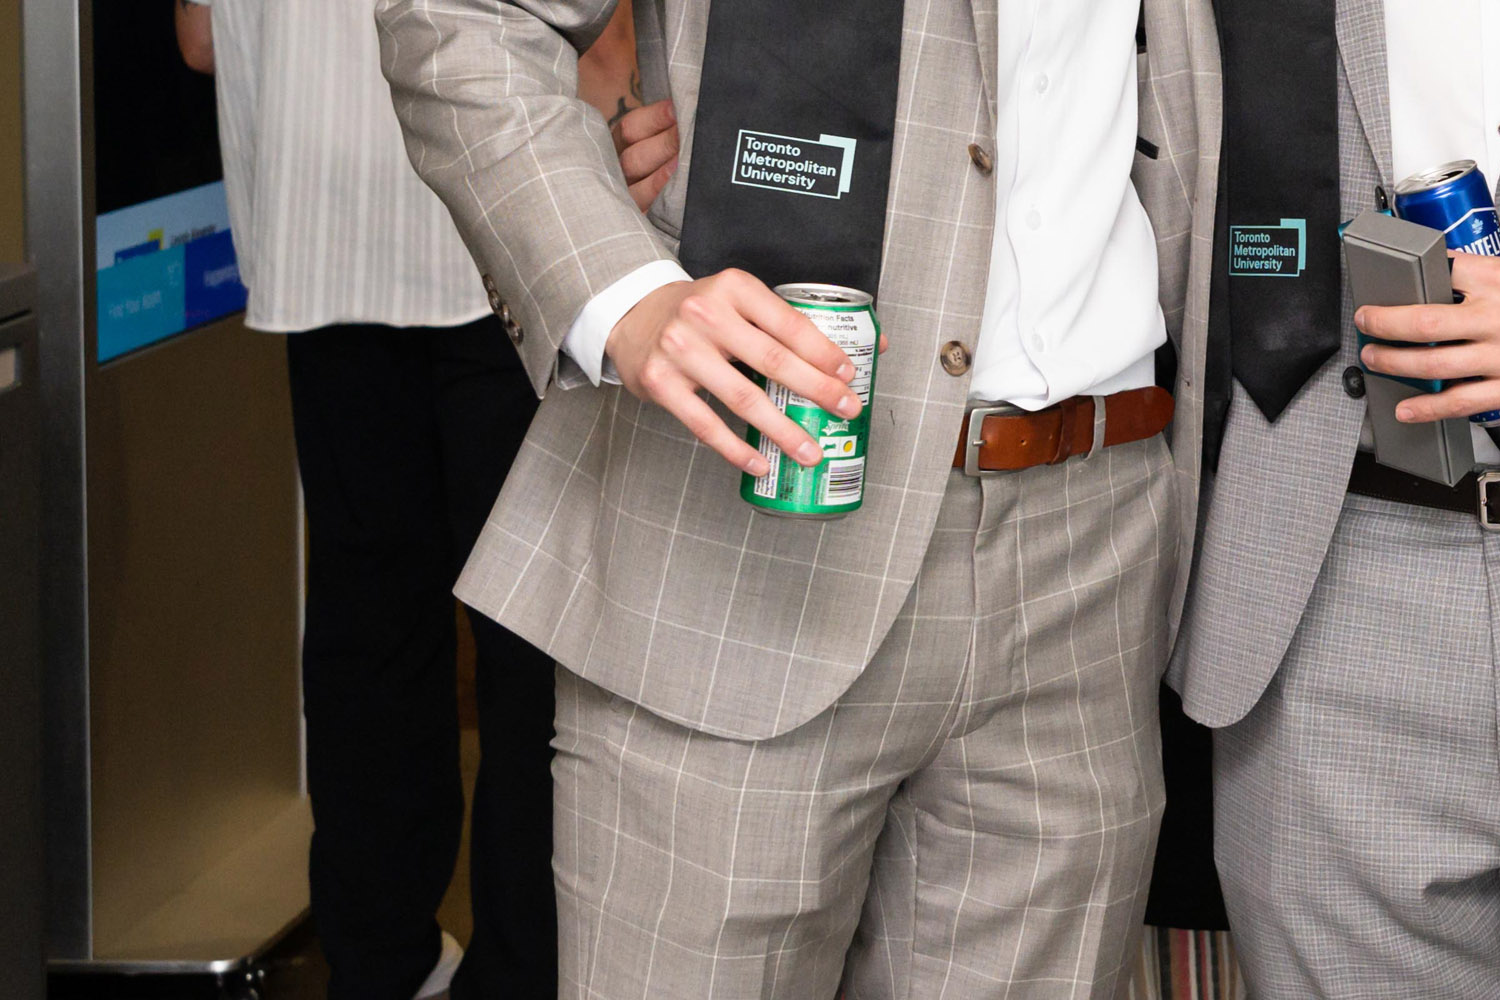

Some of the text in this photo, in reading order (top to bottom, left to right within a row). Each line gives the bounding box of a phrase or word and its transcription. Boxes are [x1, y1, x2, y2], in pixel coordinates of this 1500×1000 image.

[745, 135, 801, 157] Toronto
[742, 150, 837, 177] Metropolitan
[740, 164, 816, 190] University
[1234, 231, 1271, 243] Toronto
[1233, 244, 1296, 259] Metropolitan
[1233, 257, 1283, 272] University
[836, 315, 855, 323] Facts
[827, 324, 858, 332] nutritive
